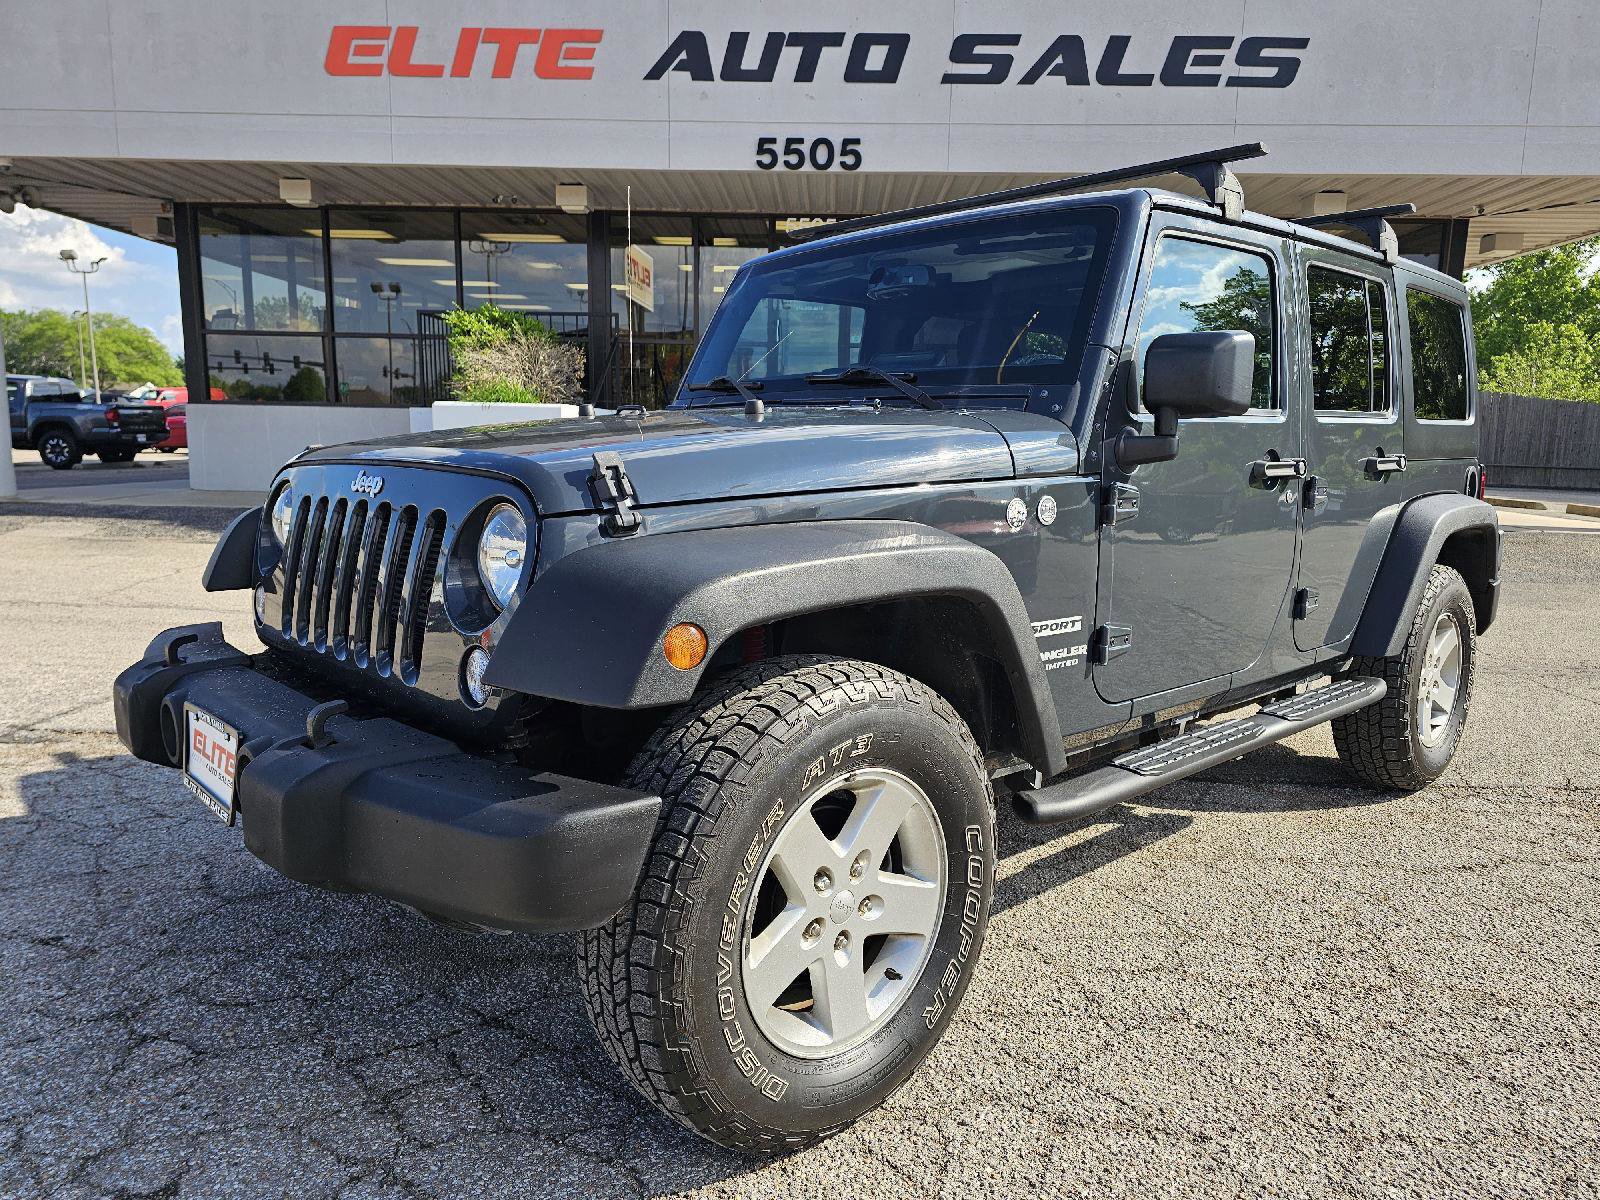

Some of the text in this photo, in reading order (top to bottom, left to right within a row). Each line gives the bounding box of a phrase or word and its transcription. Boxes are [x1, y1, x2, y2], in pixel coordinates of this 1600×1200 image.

[324, 25, 1310, 89] ELITE AUTO SALES
[756, 137, 862, 171] 5505
[350, 469, 383, 499] Jeep
[1031, 619, 1078, 635] SPORT
[193, 728, 236, 779] ELITE
[716, 797, 790, 1102] DISCOVERER
[802, 732, 873, 791] AT3
[920, 824, 984, 1031] COOPER
